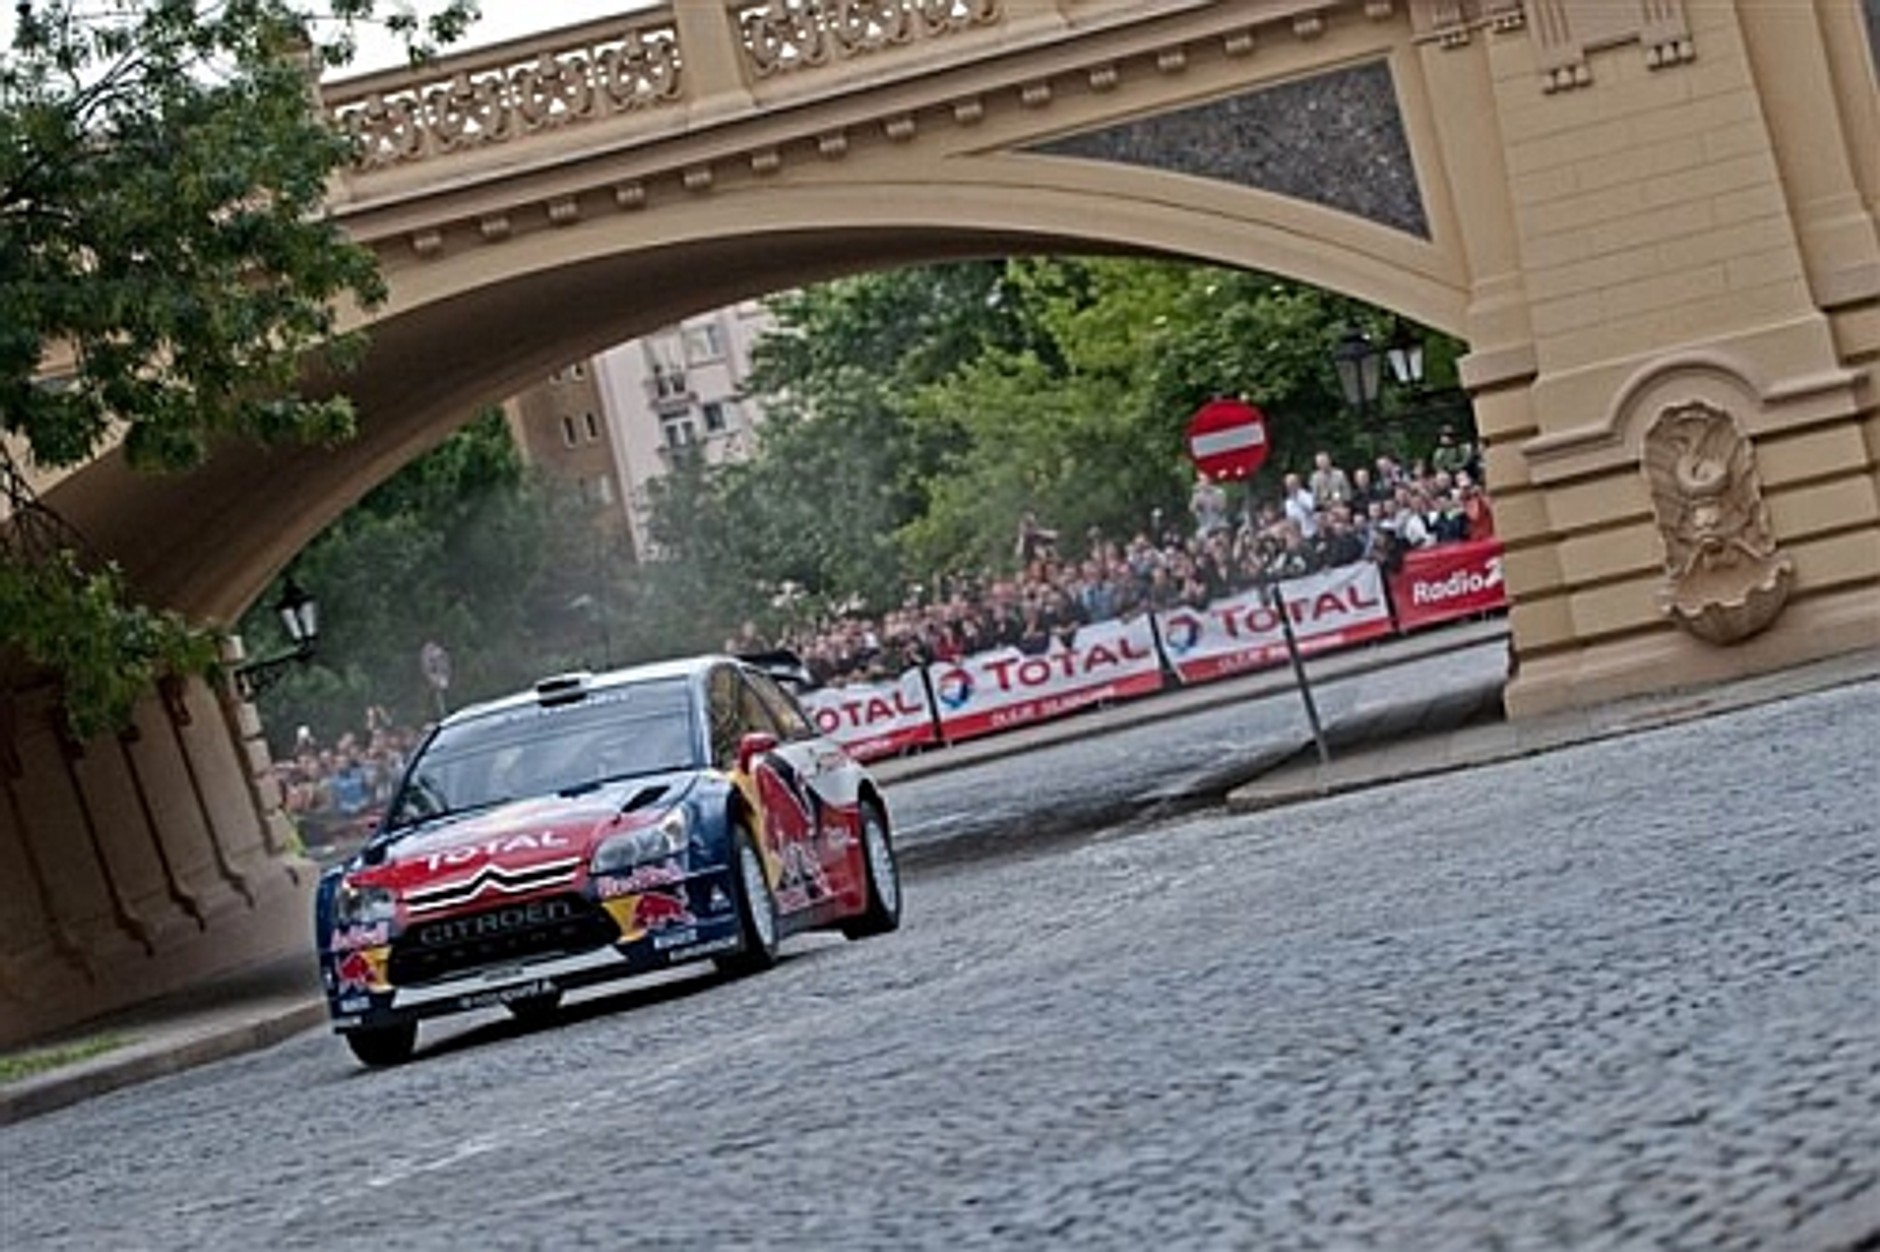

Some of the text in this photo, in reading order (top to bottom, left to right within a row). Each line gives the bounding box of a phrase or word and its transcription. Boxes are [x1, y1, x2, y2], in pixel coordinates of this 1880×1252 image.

[1212, 586, 1380, 638] TOTAL
[983, 638, 1150, 691] TOTAL
[804, 690, 922, 733] OTAL
[416, 830, 569, 871] TOTAL
